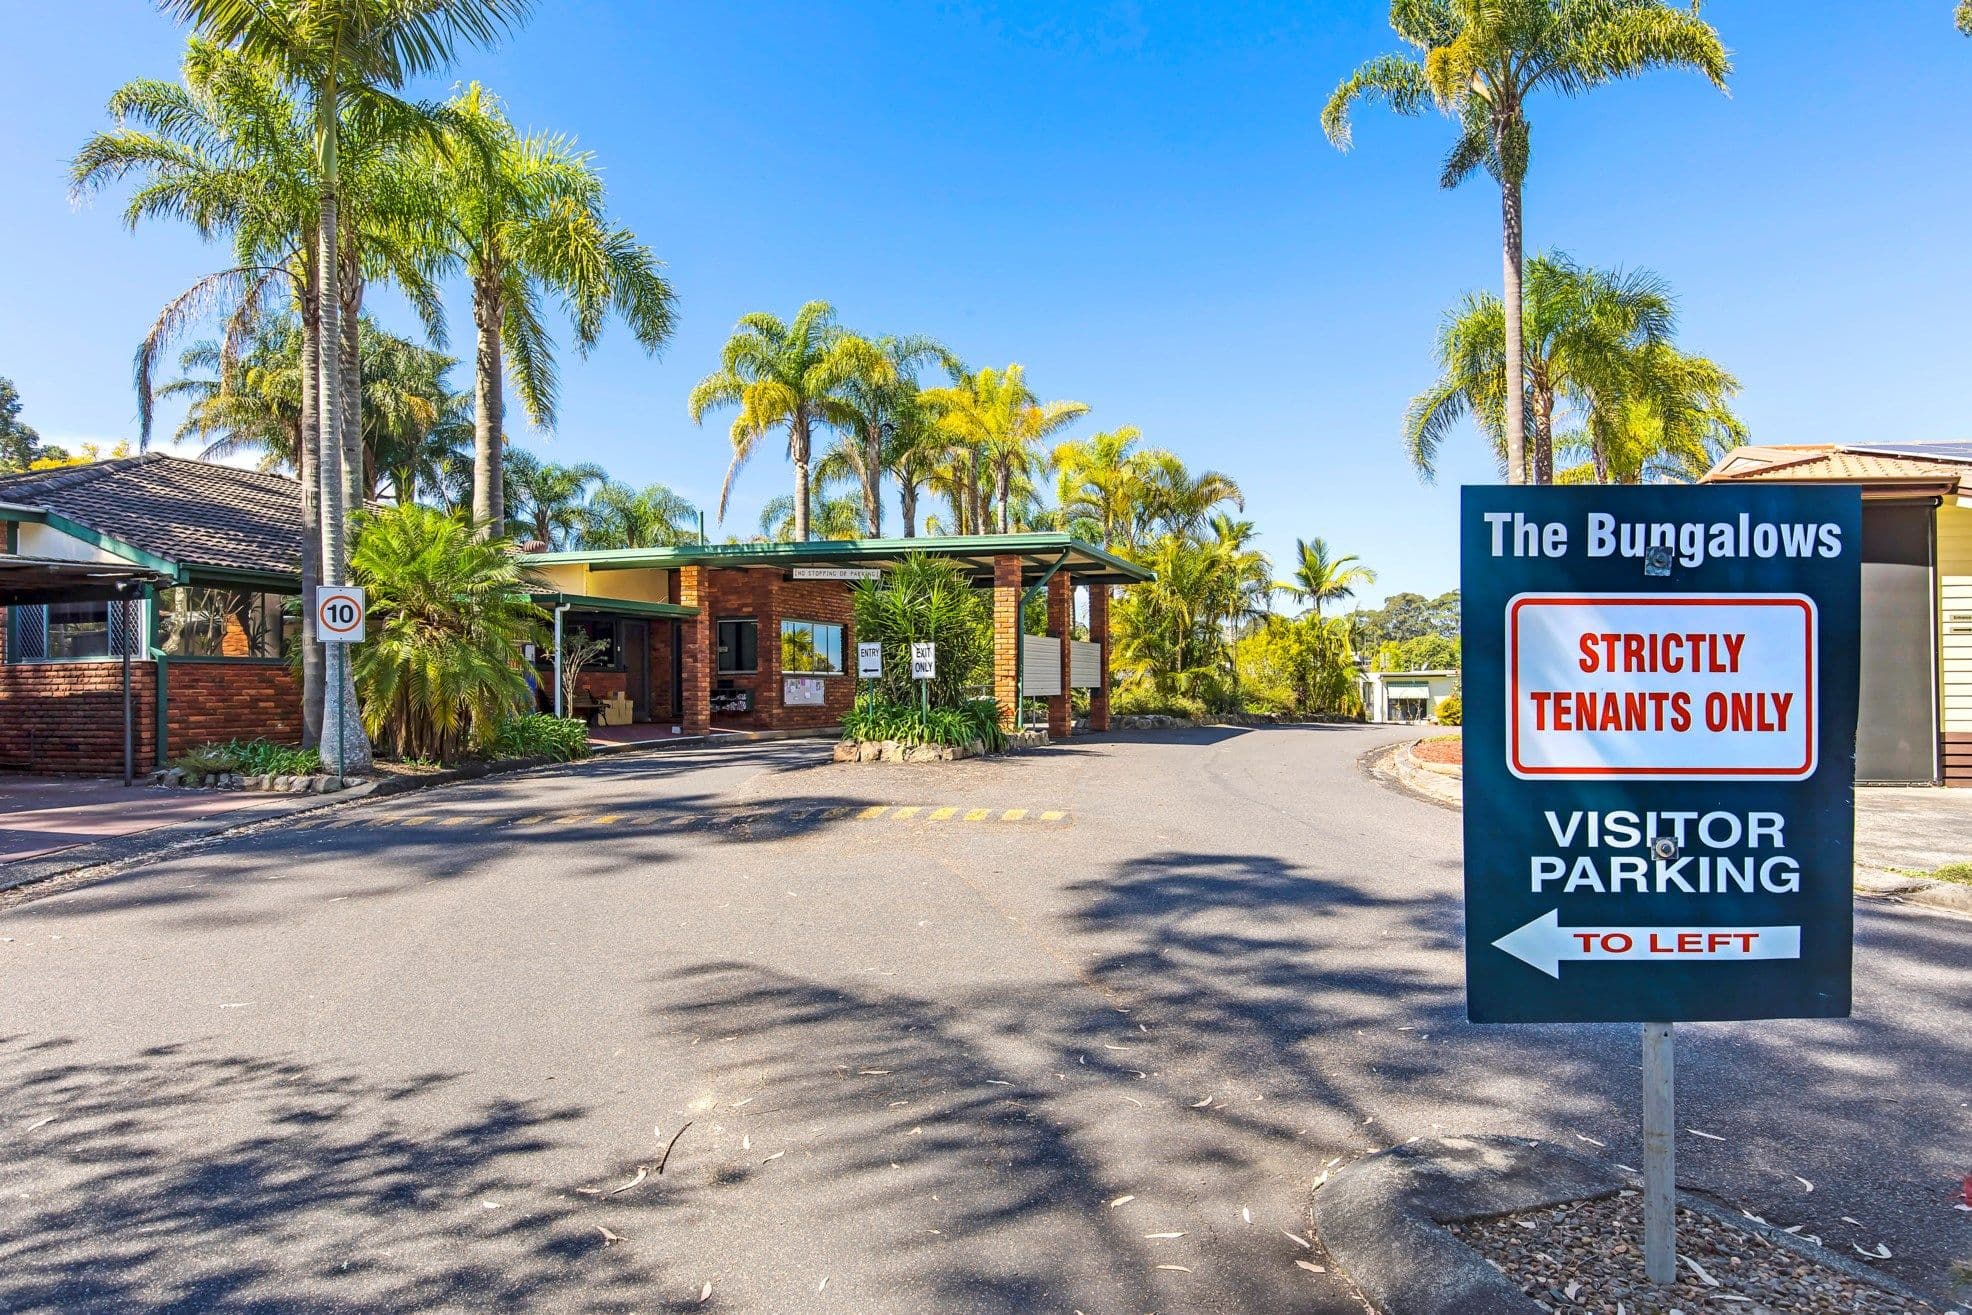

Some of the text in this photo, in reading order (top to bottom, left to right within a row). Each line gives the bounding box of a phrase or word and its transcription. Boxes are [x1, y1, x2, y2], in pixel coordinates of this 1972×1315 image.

[1484, 512, 1842, 568] The Bungalows
[327, 604, 354, 624] 10
[860, 648, 880, 658] ENTRY
[915, 662, 933, 673] ONLY
[916, 647, 931, 658] EXIT
[1579, 632, 1745, 674] STRICTLY
[1530, 691, 1794, 733] TENANTS ONLY
[1544, 810, 1785, 849] VISITOR
[1530, 853, 1800, 893] PARKING
[1573, 932, 1760, 954] TO LEFT
